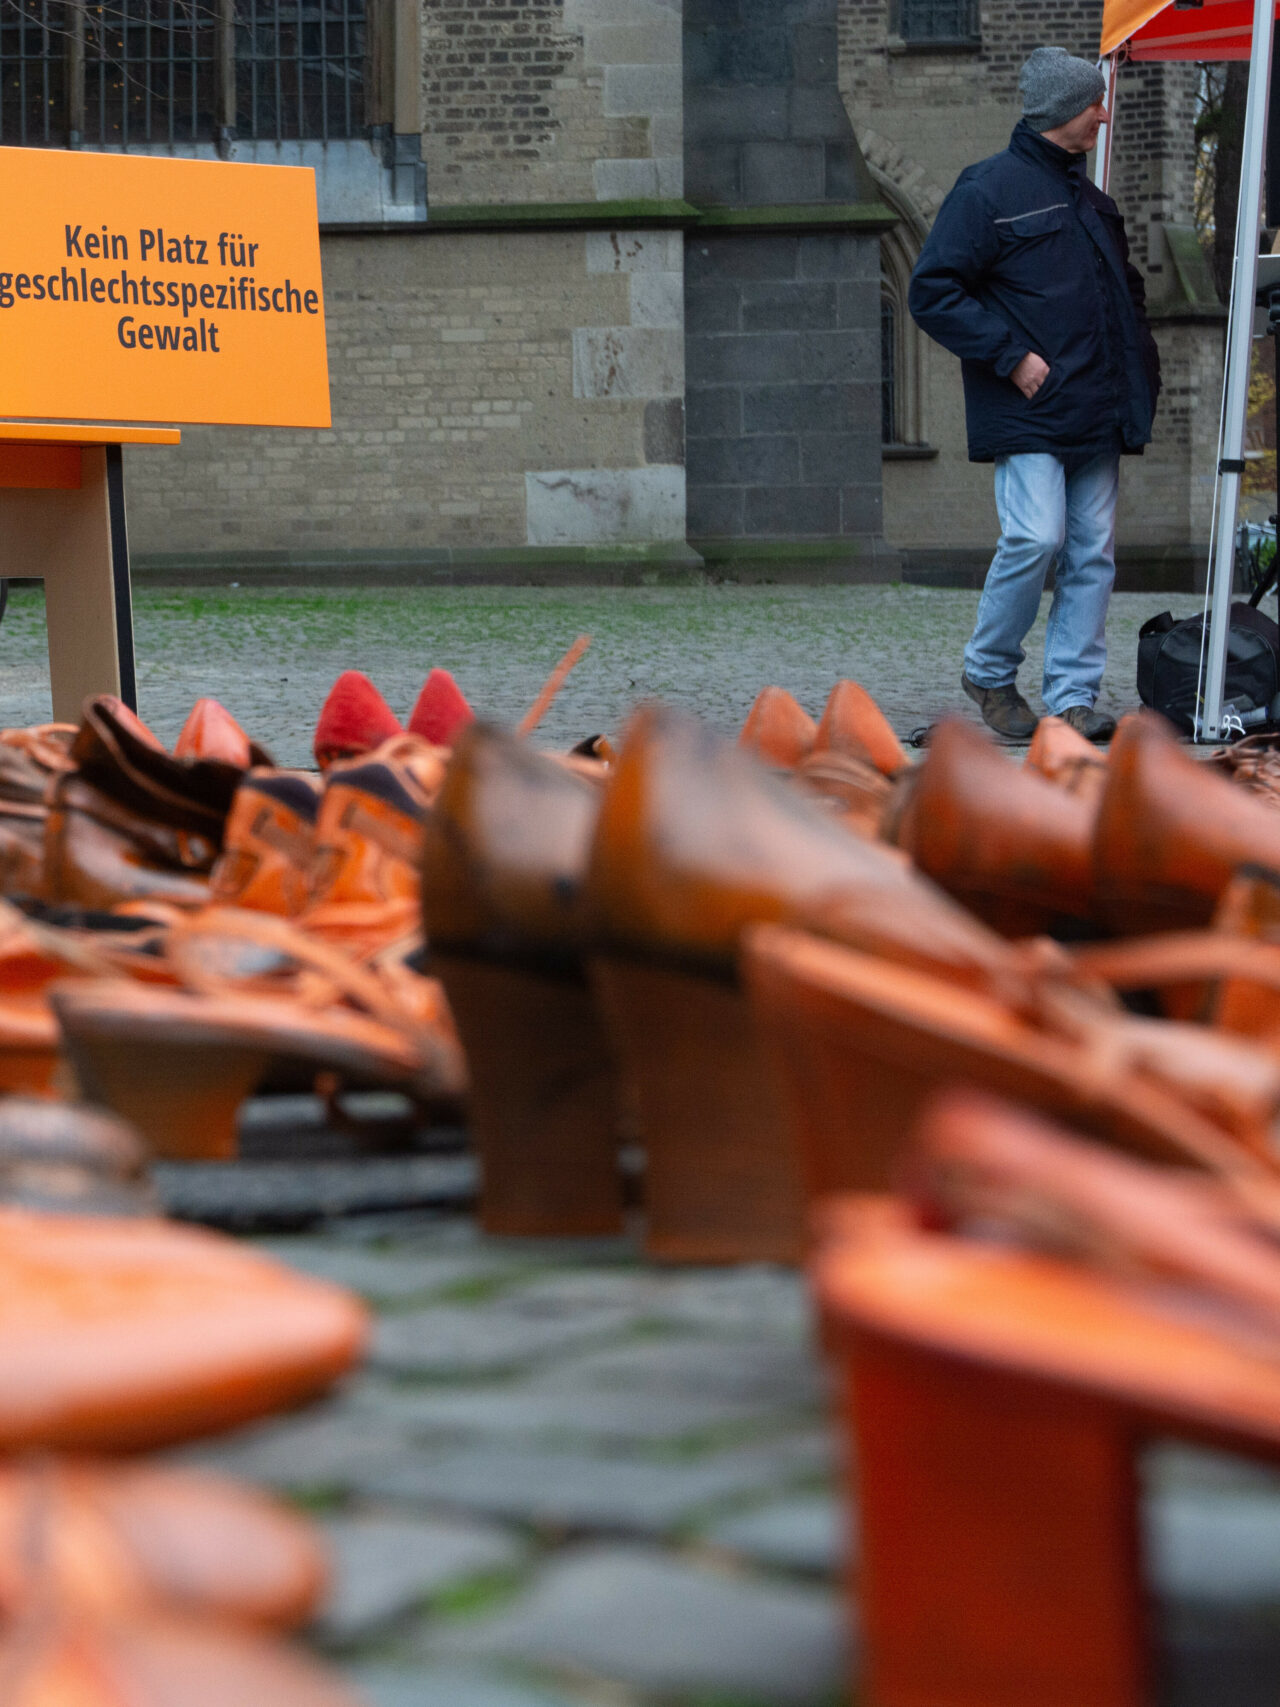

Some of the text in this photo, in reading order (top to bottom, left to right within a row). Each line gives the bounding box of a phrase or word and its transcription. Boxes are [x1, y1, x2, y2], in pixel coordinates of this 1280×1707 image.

[64, 224, 259, 267] Kein Platz für
[117, 315, 221, 353] Gewalt
